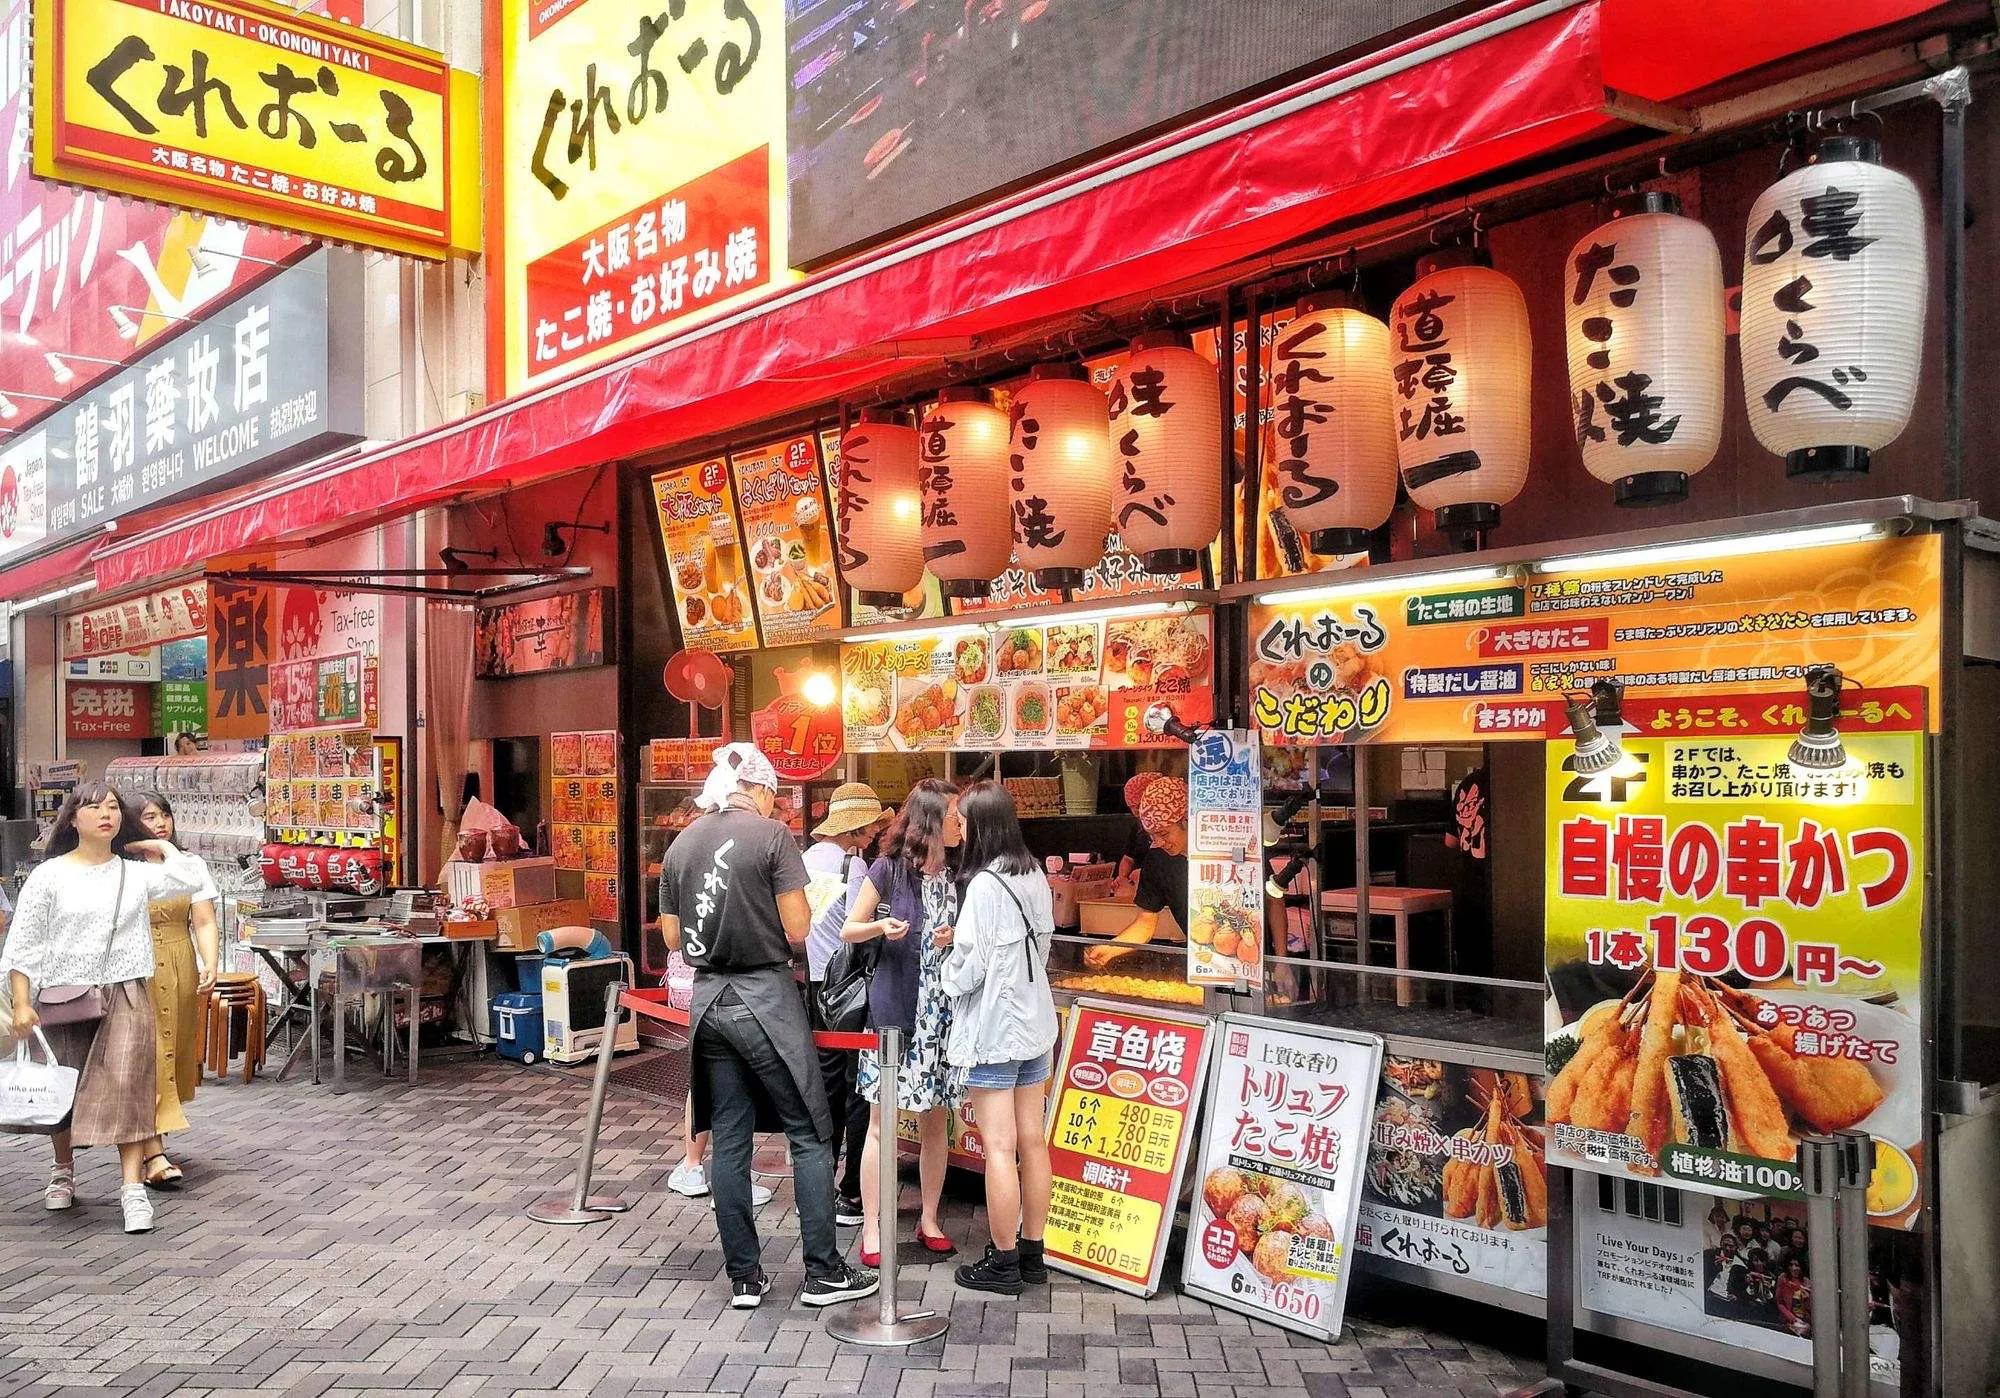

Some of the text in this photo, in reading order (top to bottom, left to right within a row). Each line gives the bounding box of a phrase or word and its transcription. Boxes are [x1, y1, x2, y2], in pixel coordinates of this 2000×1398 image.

[86, 35, 427, 184] くれおーる
[151, 146, 377, 214] 大阪名物 たこ焼・お好み焼
[582, 198, 688, 286] 大阪名物
[535, 226, 758, 362] たこ焼・お好み焼
[1749, 185, 1882, 414] 味くらべ
[1572, 242, 1683, 450] たこ焼
[1274, 321, 1340, 509] くれおーる
[81, 485, 105, 519] SALE
[192, 415, 260, 473] WELCOME
[1108, 365, 1176, 530] 味くらべ
[1009, 400, 1066, 549] たこ焼
[839, 435, 870, 572] くれおーる
[331, 606, 376, 633] Tax-free
[1416, 594, 1514, 620] たこ焼の生地
[1260, 608, 1386, 662] くれおーる
[1494, 626, 1590, 652] 大きなたこ
[1310, 662, 1333, 686] の
[1409, 669, 1517, 693] 特製だし醤油
[71, 687, 136, 718] 免税
[1255, 679, 1391, 736] こだわり
[1478, 707, 1546, 729] まろやか
[1651, 701, 1912, 730] ようこそ、くれーるへ
[72, 720, 132, 733] Tax-Free
[1199, 863, 1257, 885] 明太子
[1561, 815, 1911, 909] 自慢の串かつ
[684, 838, 736, 957] くれおーる
[1757, 1002, 1856, 1032] あつあつ
[1086, 1020, 1186, 1077] 章鱼烧
[1257, 1043, 1338, 1075] 上質な香り
[1794, 1032, 1902, 1065] 揚げたて
[1079, 1096, 1101, 1114] 6个
[1240, 1063, 1349, 1120] トリュフ
[1064, 1131, 1093, 1150] 16个
[1068, 1113, 1097, 1132] 10个
[1231, 1109, 1341, 1173] たこ焼
[1370, 1122, 1513, 1168] 好み焼×串カツ
[1082, 1160, 1132, 1193] 调味汁
[1207, 1225, 1236, 1249] ココ
[1380, 1227, 1470, 1275] くれおーる
[1625, 1239, 1650, 1255] Your
